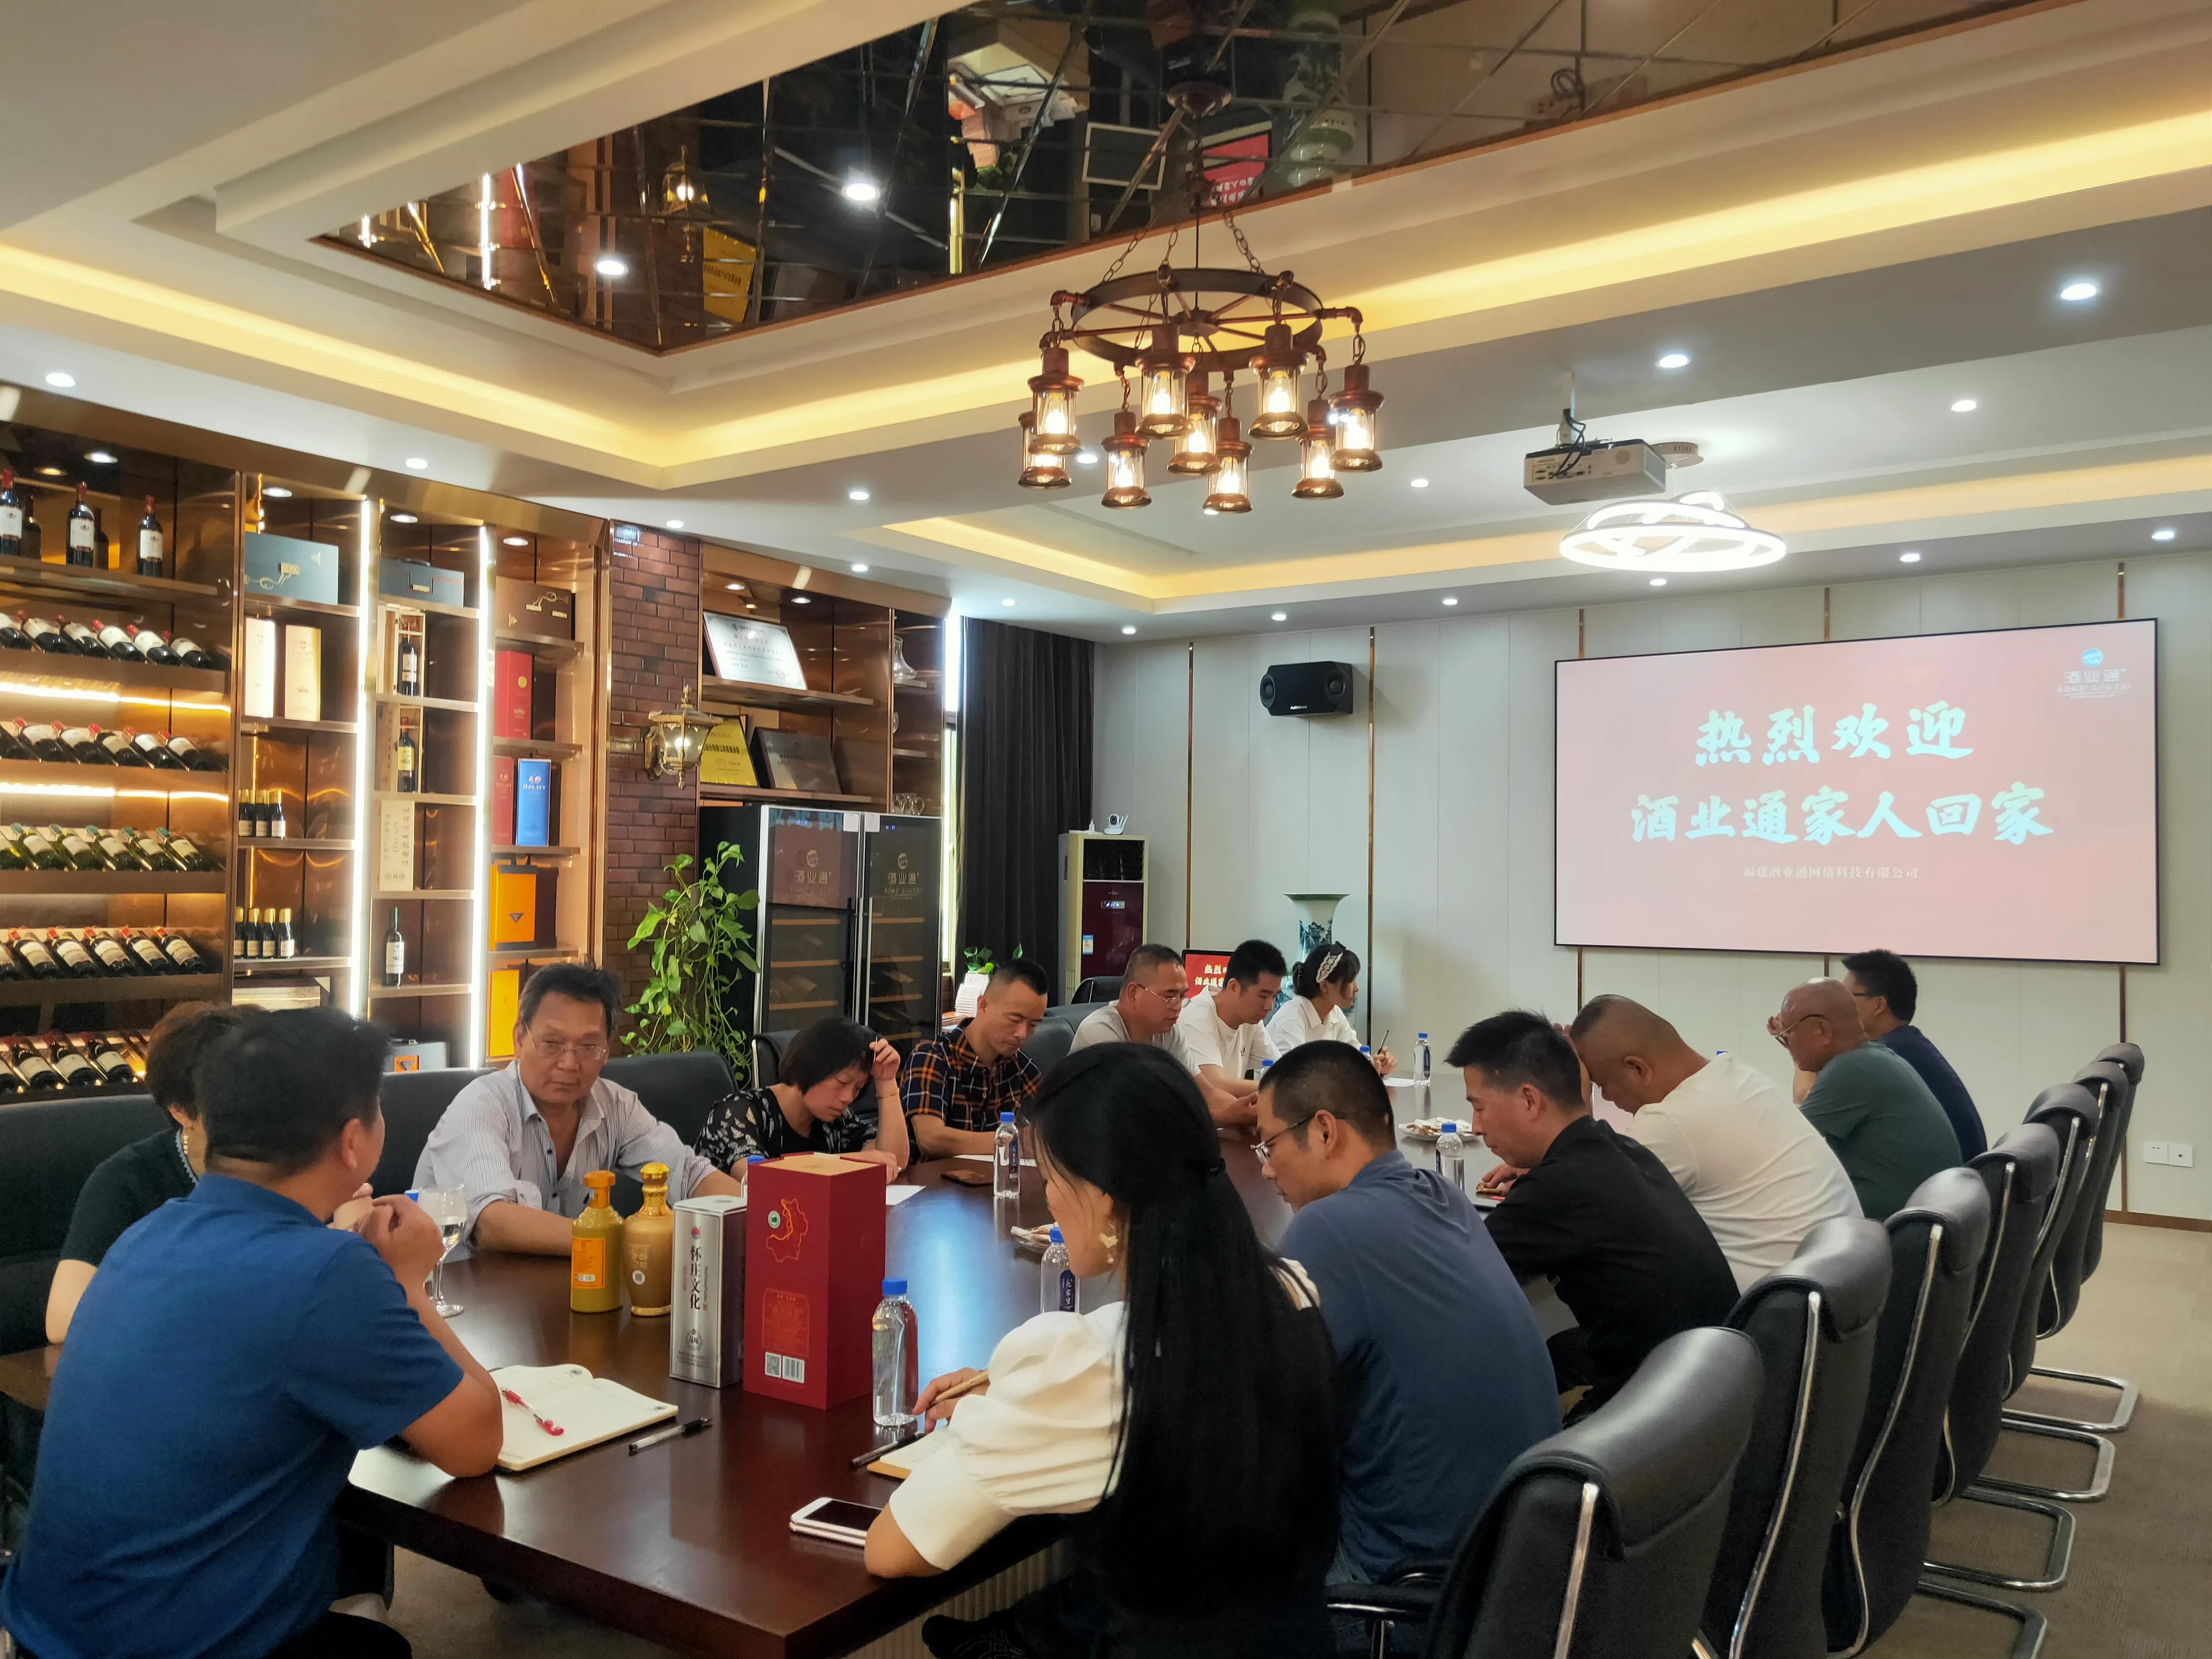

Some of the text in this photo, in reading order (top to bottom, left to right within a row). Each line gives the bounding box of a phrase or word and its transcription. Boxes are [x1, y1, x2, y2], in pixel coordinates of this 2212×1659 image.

[2065, 669, 2120, 684] 酒业通
[1695, 700, 1974, 766] 热烈欢迎
[1631, 781, 2054, 845] 酒业通家人回家
[795, 870, 828, 884] 酒业通
[888, 872, 916, 885] 酒业通
[1744, 866, 1918, 879] 福建酒业通网络科技有限公司
[690, 1245, 701, 1310] 怀庄文化
